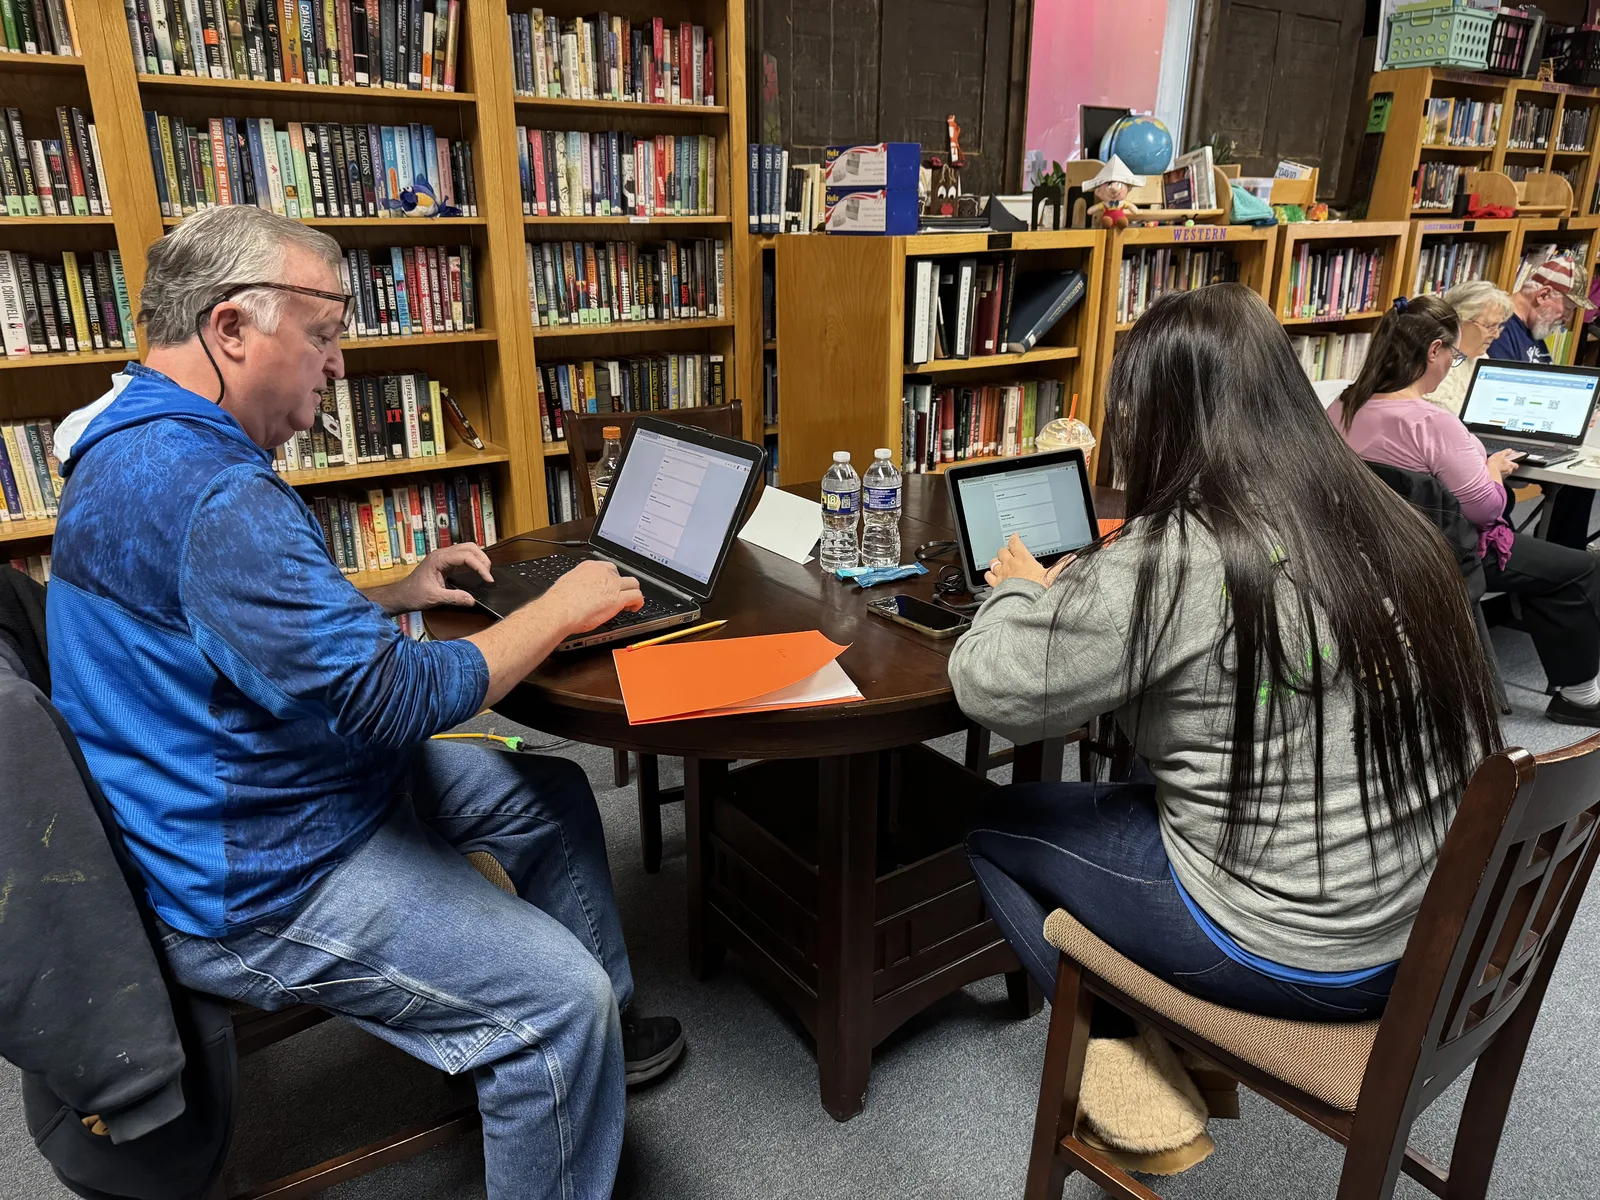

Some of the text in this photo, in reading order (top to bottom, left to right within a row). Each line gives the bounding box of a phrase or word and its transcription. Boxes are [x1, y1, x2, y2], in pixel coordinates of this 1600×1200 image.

[300, 4, 313, 43] CATALYST
[249, 48, 257, 71] Option
[64, 126, 74, 156] BURNING
[212, 121, 222, 140] BOOK
[215, 142, 226, 167] LOVERS
[358, 127, 370, 175] JACK HIGGINS
[3, 156, 12, 172] LONG
[218, 170, 228, 186] EMILY
[1174, 228, 1226, 241] WESTERN
[2, 286, 19, 320] CORNWELL
[367, 383, 375, 408] STEPHEN
[386, 409, 402, 423] IT
[404, 379, 413, 400] STEPHEN
[410, 425, 418, 449] MERCEDES
[42, 430, 52, 444] JUDE
[29, 430, 47, 475] JUDE DEVERAUX
